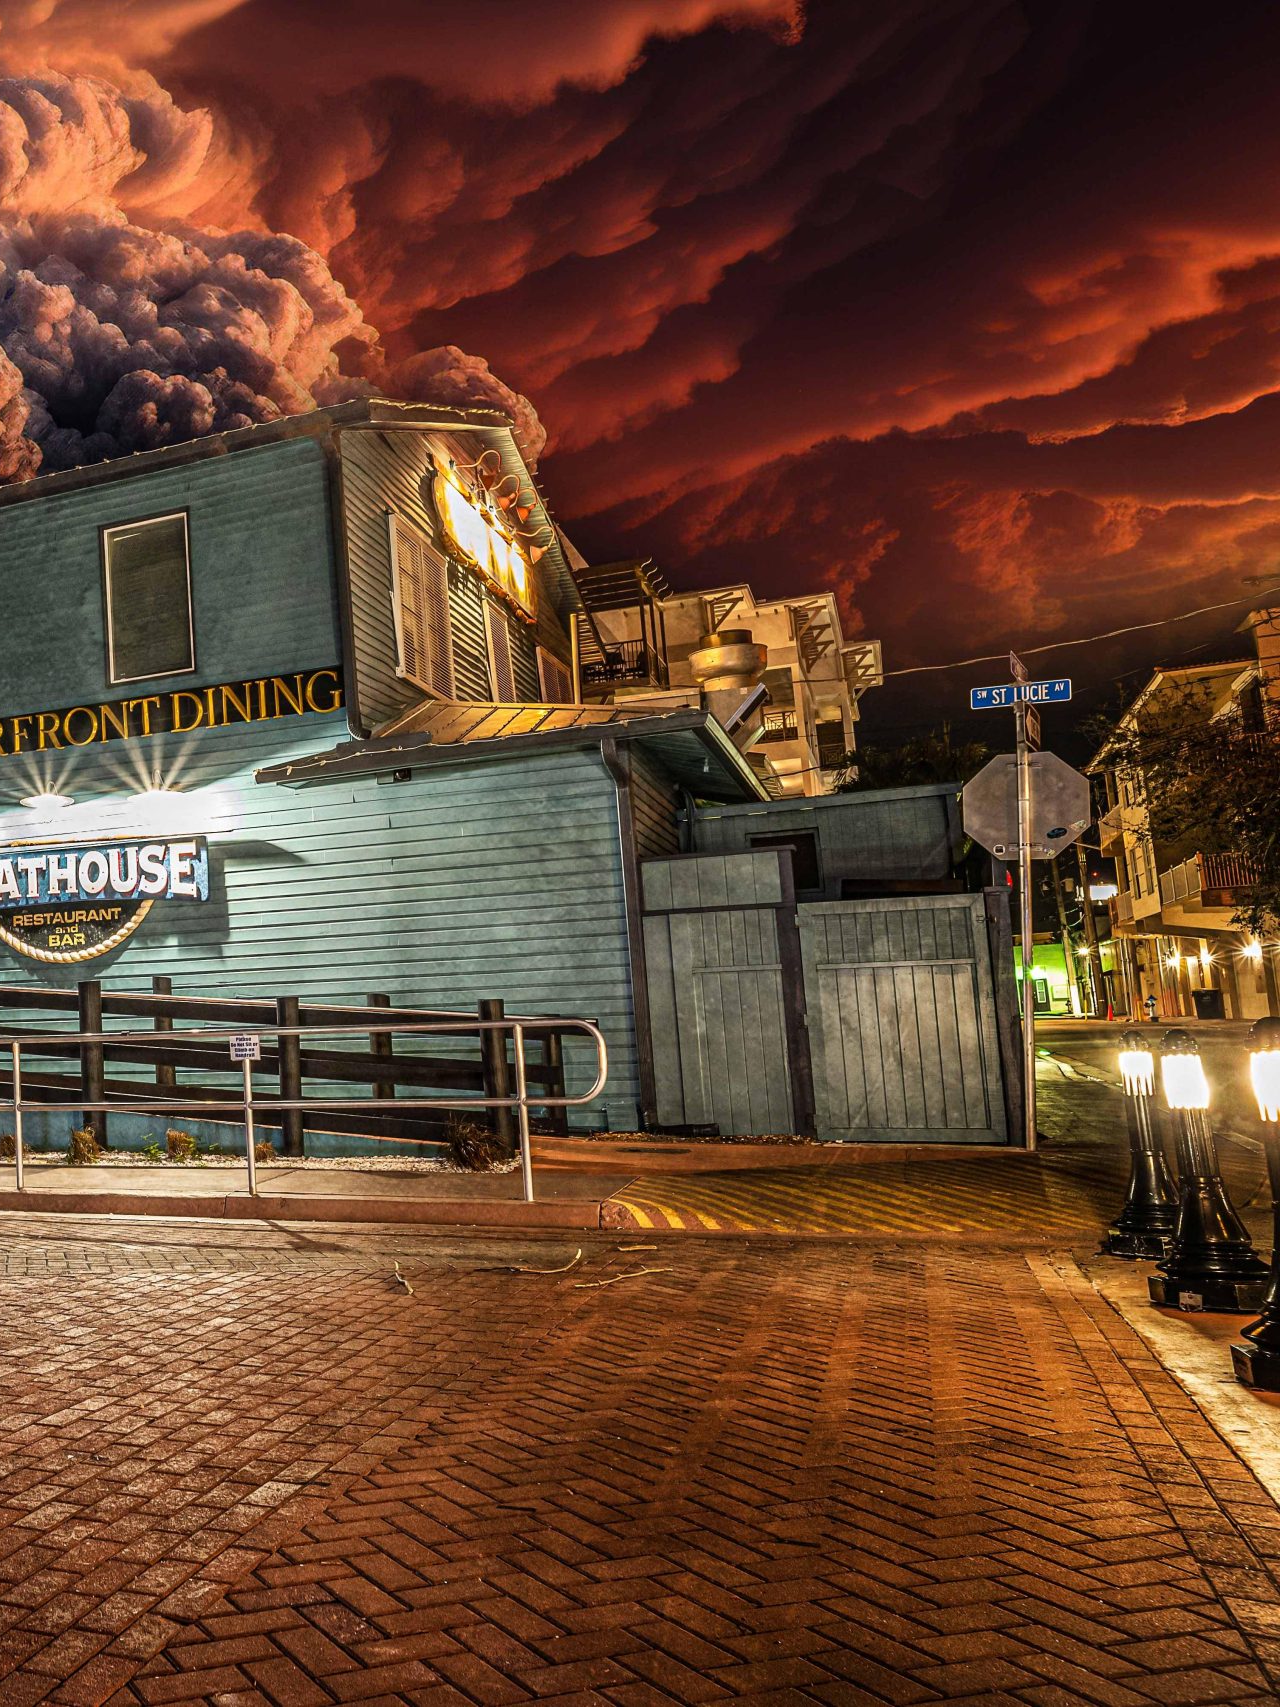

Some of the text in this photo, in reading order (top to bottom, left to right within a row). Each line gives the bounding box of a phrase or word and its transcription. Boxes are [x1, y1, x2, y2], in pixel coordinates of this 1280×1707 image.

[170, 670, 343, 733] DINING
[977, 682, 1065, 704] SW ST LUCIE AV
[12, 907, 122, 928] RESTAURANT
[55, 924, 79, 934] and
[48, 933, 86, 947] BAR
